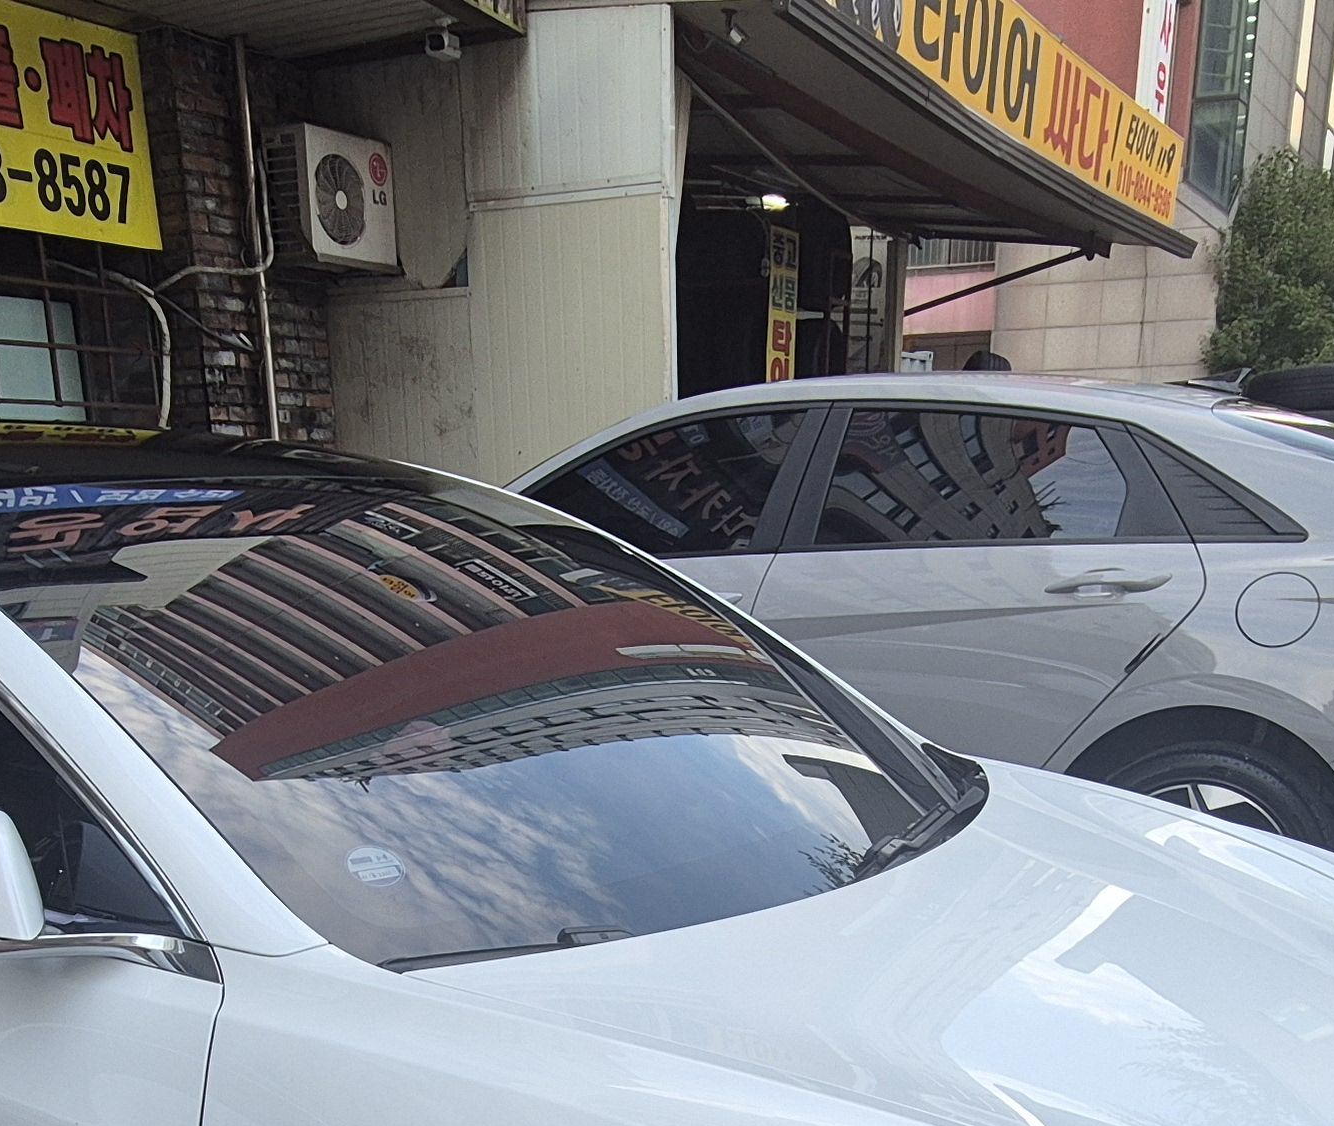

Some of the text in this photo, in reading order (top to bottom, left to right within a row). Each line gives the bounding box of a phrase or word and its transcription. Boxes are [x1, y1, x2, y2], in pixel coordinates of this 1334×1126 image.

[1126, 114, 1176, 178] 타이어 119
[372, 189, 387, 206] LG
[772, 233, 797, 270] 중고
[771, 274, 795, 314] 신품
